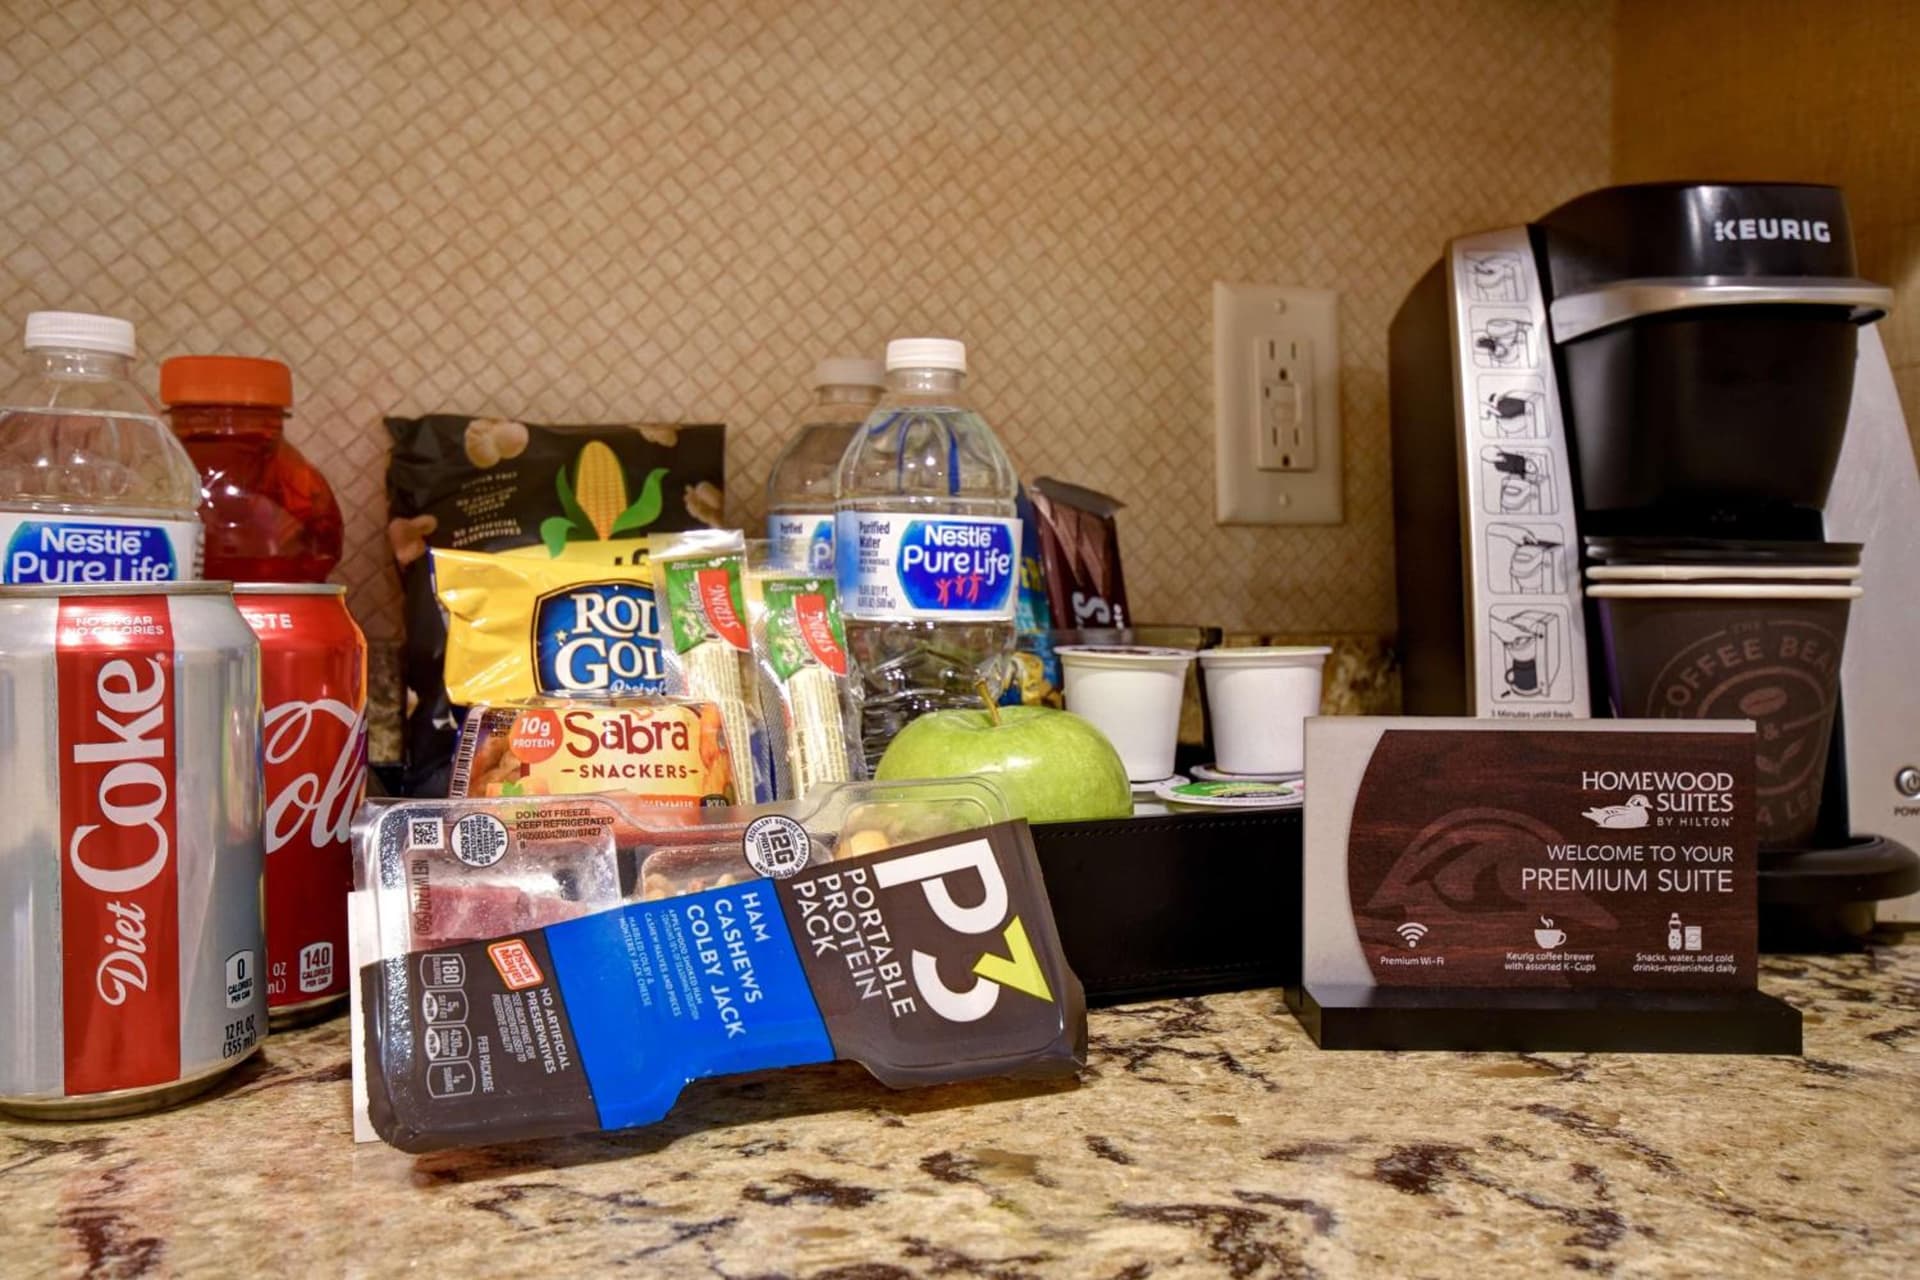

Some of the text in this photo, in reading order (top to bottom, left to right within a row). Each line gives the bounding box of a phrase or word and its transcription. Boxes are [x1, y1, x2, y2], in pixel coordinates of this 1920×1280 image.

[1714, 218, 1831, 243] KEURIG
[859, 521, 890, 535] Purified
[859, 535, 881, 548] Water
[903, 545, 970, 574] Pure
[975, 549, 1010, 586] Life
[246, 613, 293, 629] STE
[570, 592, 660, 639] ROL
[554, 637, 664, 690] GOL
[1779, 635, 1836, 680] BEA
[521, 717, 551, 737] 10g
[564, 711, 689, 758] Sabra
[512, 738, 555, 749] PROTEIN
[579, 764, 688, 779] SNACKERS
[1581, 771, 1734, 791] HOMEWOOD
[515, 808, 591, 819] DO NOT FREEZE
[1656, 793, 1734, 812] SUITES
[1894, 806, 1920, 816] POW
[70, 655, 169, 1006] Diet Coke
[516, 816, 615, 830] KEEP REFRIGERATED
[1657, 817, 1731, 827] BY HILTON
[758, 832, 775, 867] PROTEIN
[768, 827, 795, 864] 12G
[1546, 845, 1734, 862] WELCOME TO YOUR
[411, 859, 429, 875] NET
[1522, 867, 1734, 893] PREMIUM SUITE
[741, 892, 771, 942] HAM
[792, 880, 839, 957] PACK
[817, 873, 882, 1001] PROTEIN
[843, 867, 917, 1018] PORTABLE
[872, 838, 1055, 1022] P3
[304, 947, 330, 970] 140
[628, 916, 644, 950] MARBLED
[638, 951, 652, 976] COLBY
[668, 908, 688, 954] APPLEWOOD
[682, 955, 698, 985] SMOKED
[692, 986, 703, 1004] HAM
[715, 899, 763, 1003] CASHEWS
[1506, 951, 1595, 963] Keurig coffee brewer
[1697, 954, 1713, 962] and
[1715, 954, 1734, 962] cold
[237, 958, 245, 980] 0
[273, 962, 287, 976] OZ
[441, 958, 460, 983] 180
[498, 948, 525, 983] Mayer
[512, 948, 536, 979] Oscar
[618, 917, 651, 1006] MONTEREY JACK CHEESE
[644, 912, 681, 1016] CASHEW HALVES AND PIECES
[687, 904, 747, 1039] COLBY JACK
[1380, 956, 1444, 966] Premium Wi-Fi
[1504, 962, 1596, 974] with assorted K-Cups
[1716, 964, 1737, 975] daily
[225, 1024, 234, 1040] 12
[236, 1019, 244, 1036] FL
[525, 991, 556, 1074] PRESERVATIVES
[540, 988, 571, 1071] NO ARTIFICIAL
[223, 1040, 241, 1059] (355
[477, 1036, 495, 1094] PER PACKAGE
